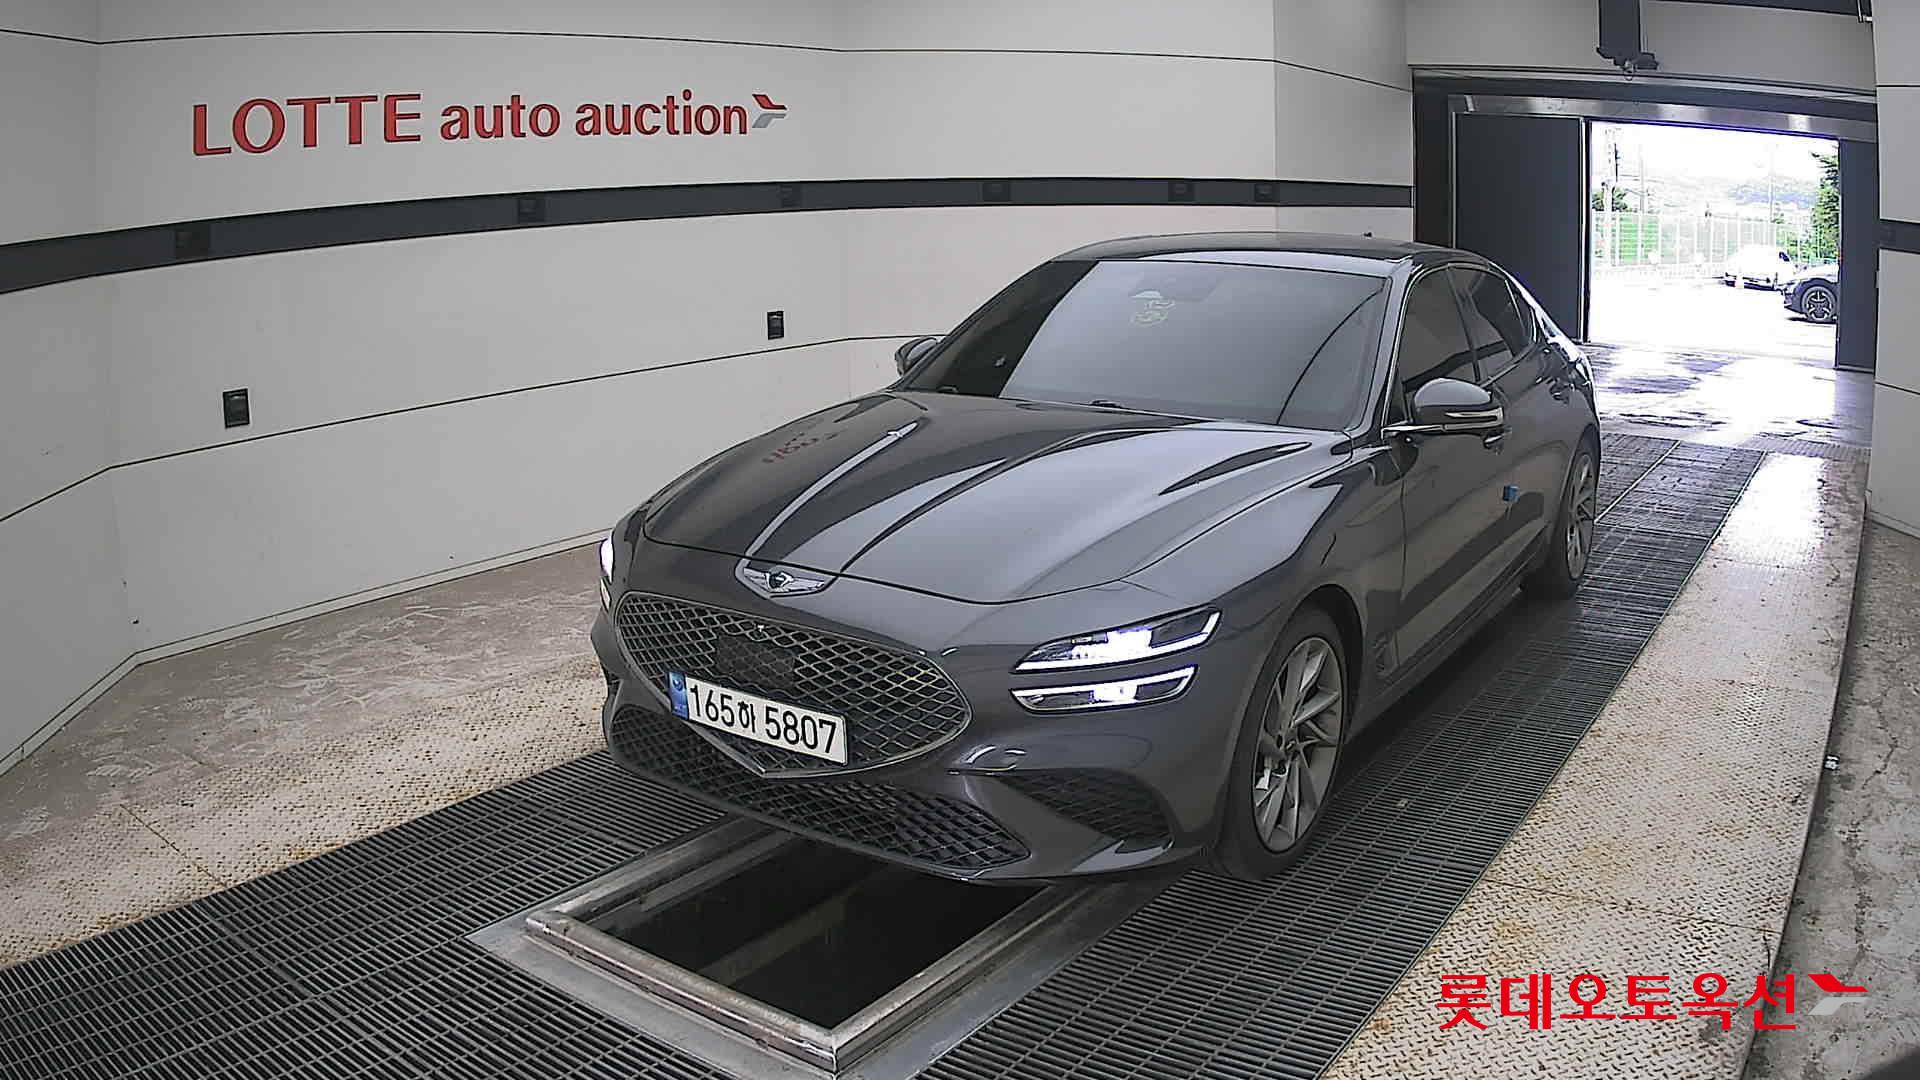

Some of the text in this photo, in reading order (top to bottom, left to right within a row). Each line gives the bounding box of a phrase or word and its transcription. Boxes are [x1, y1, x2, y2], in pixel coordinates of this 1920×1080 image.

[192, 89, 749, 156] LOTTE auto auction
[690, 685, 837, 753] 165하 5807
